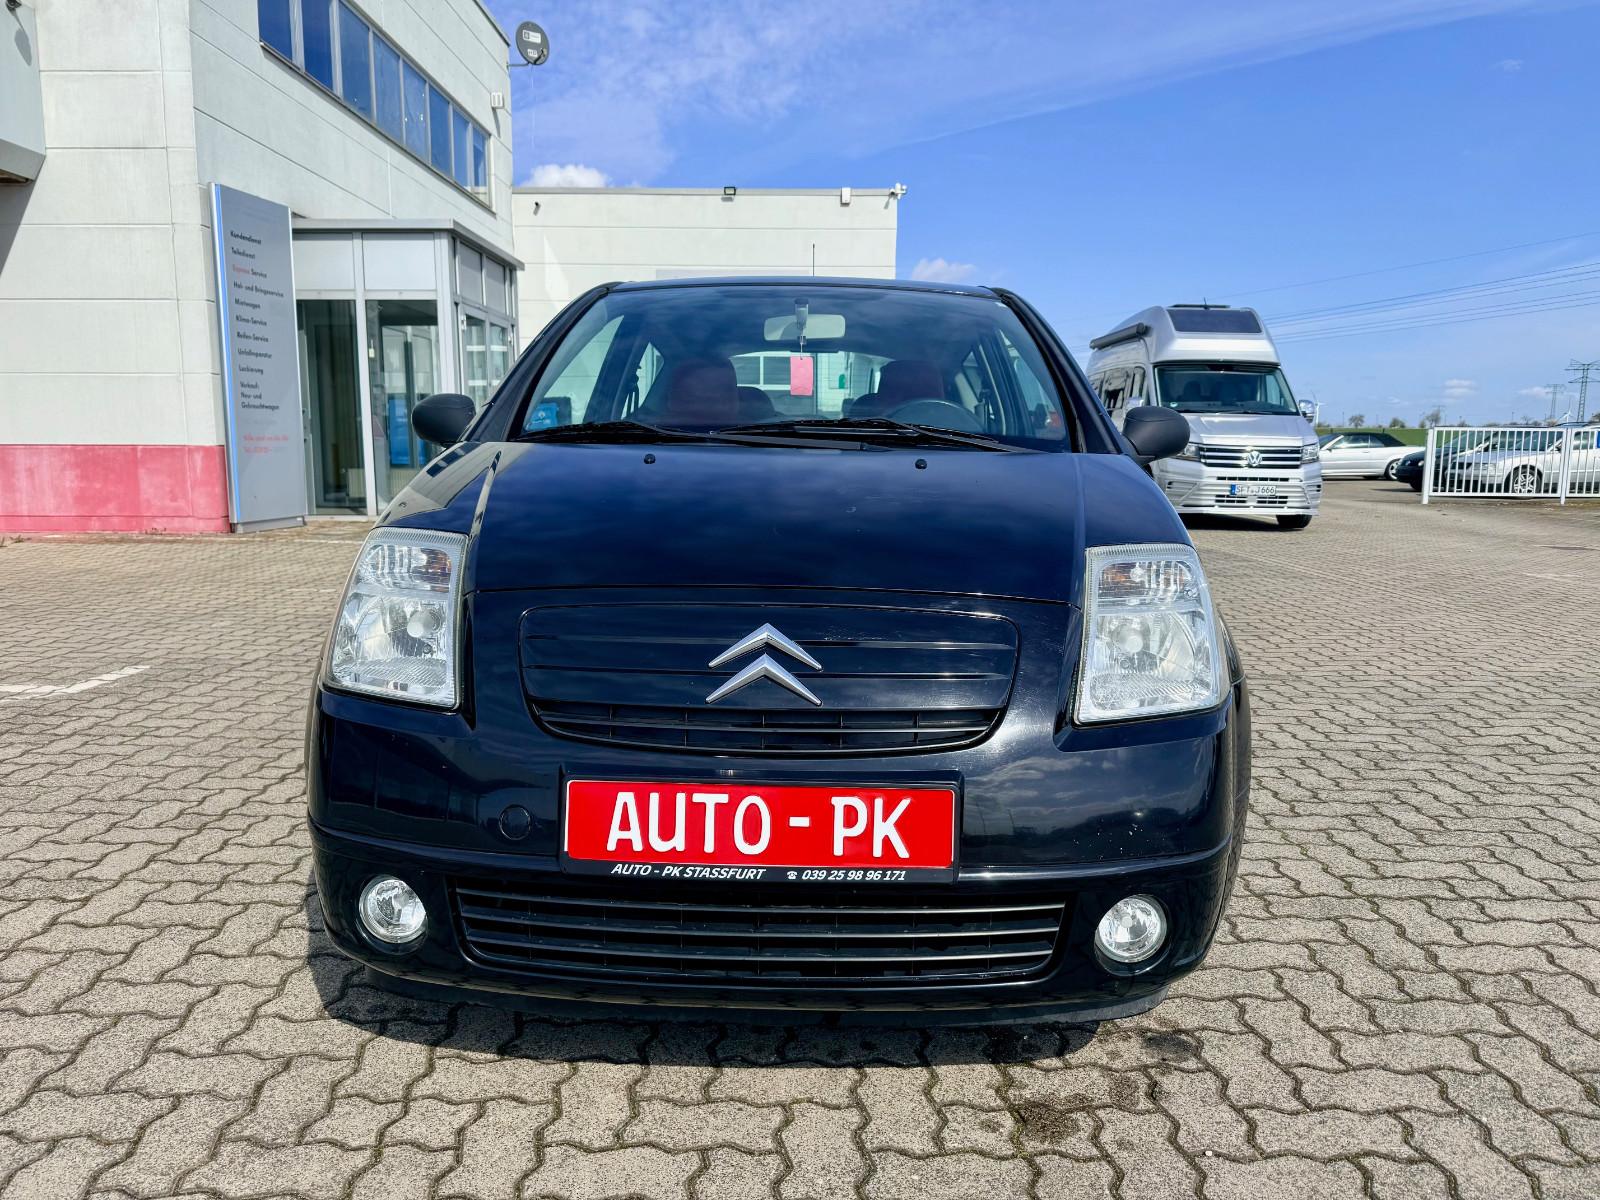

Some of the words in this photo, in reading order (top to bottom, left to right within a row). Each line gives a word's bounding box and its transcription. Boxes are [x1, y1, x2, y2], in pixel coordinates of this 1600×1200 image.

[230, 230, 261, 244] Kundendienst
[251, 268, 267, 278] Service
[234, 297, 261, 309] Mietwagen
[606, 792, 771, 855] AUTO
[831, 796, 911, 859] PK
[611, 863, 651, 876] AUTO
[661, 865, 685, 877] PK
[684, 866, 767, 880] STASSFURT
[801, 869, 827, 880] 039
[828, 870, 846, 880] 25
[847, 870, 864, 881] 98
[865, 870, 883, 881] 96
[883, 870, 907, 881] 171
